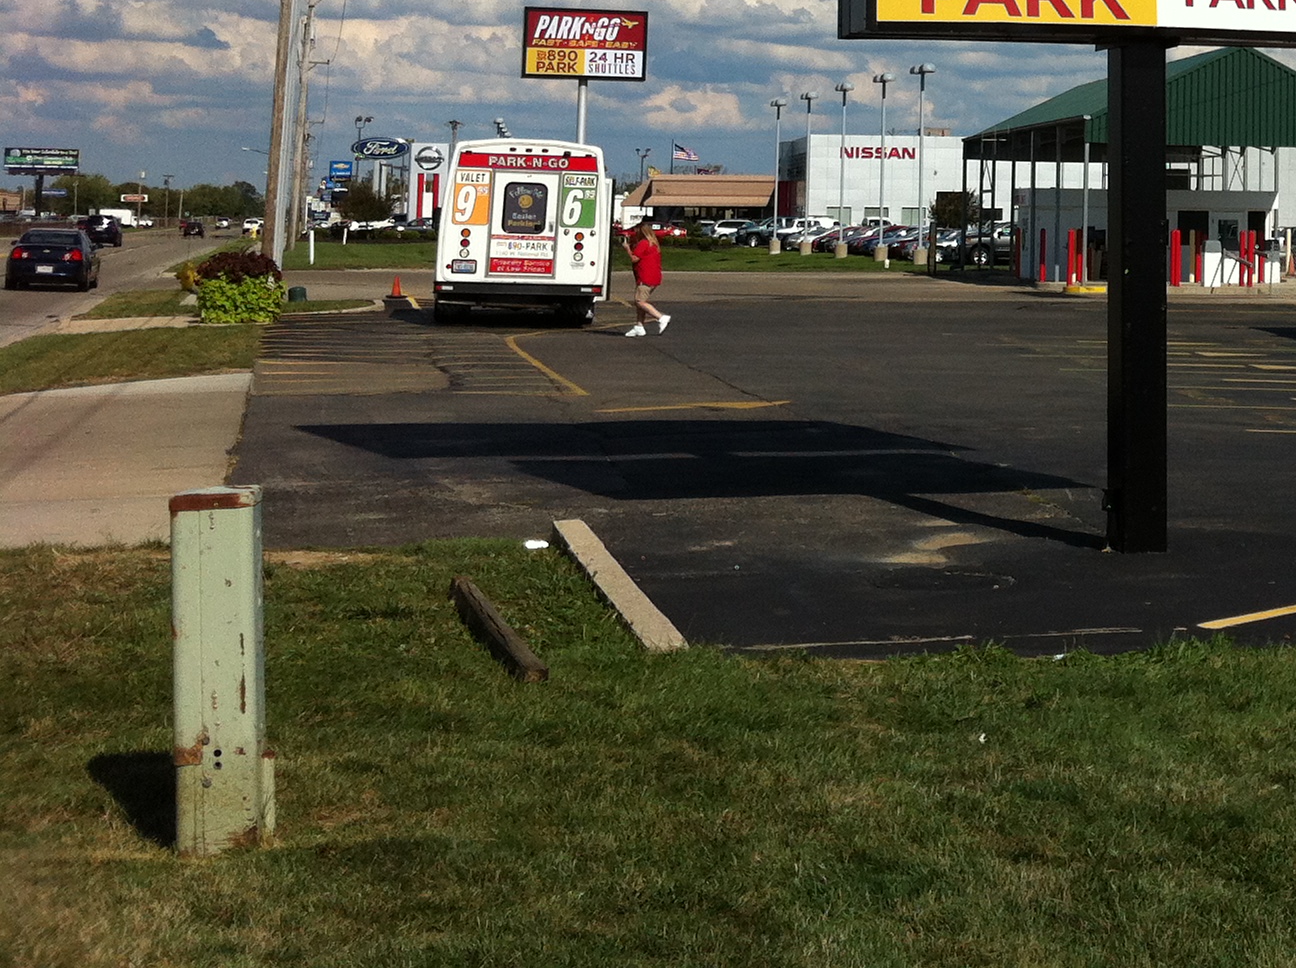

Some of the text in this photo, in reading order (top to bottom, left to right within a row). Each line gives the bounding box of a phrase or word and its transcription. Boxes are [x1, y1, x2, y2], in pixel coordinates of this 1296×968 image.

[533, 15, 586, 40] PARK
[594, 17, 620, 41] GO
[547, 50, 578, 62] 890
[589, 52, 636, 64] 24 HR
[536, 62, 578, 73] PARK
[588, 63, 636, 75] SHUTTLES
[363, 141, 399, 155] Ford
[840, 147, 915, 159] NISSAN
[460, 173, 486, 183] VALET
[455, 185, 477, 222] 9
[563, 189, 583, 226] 6
